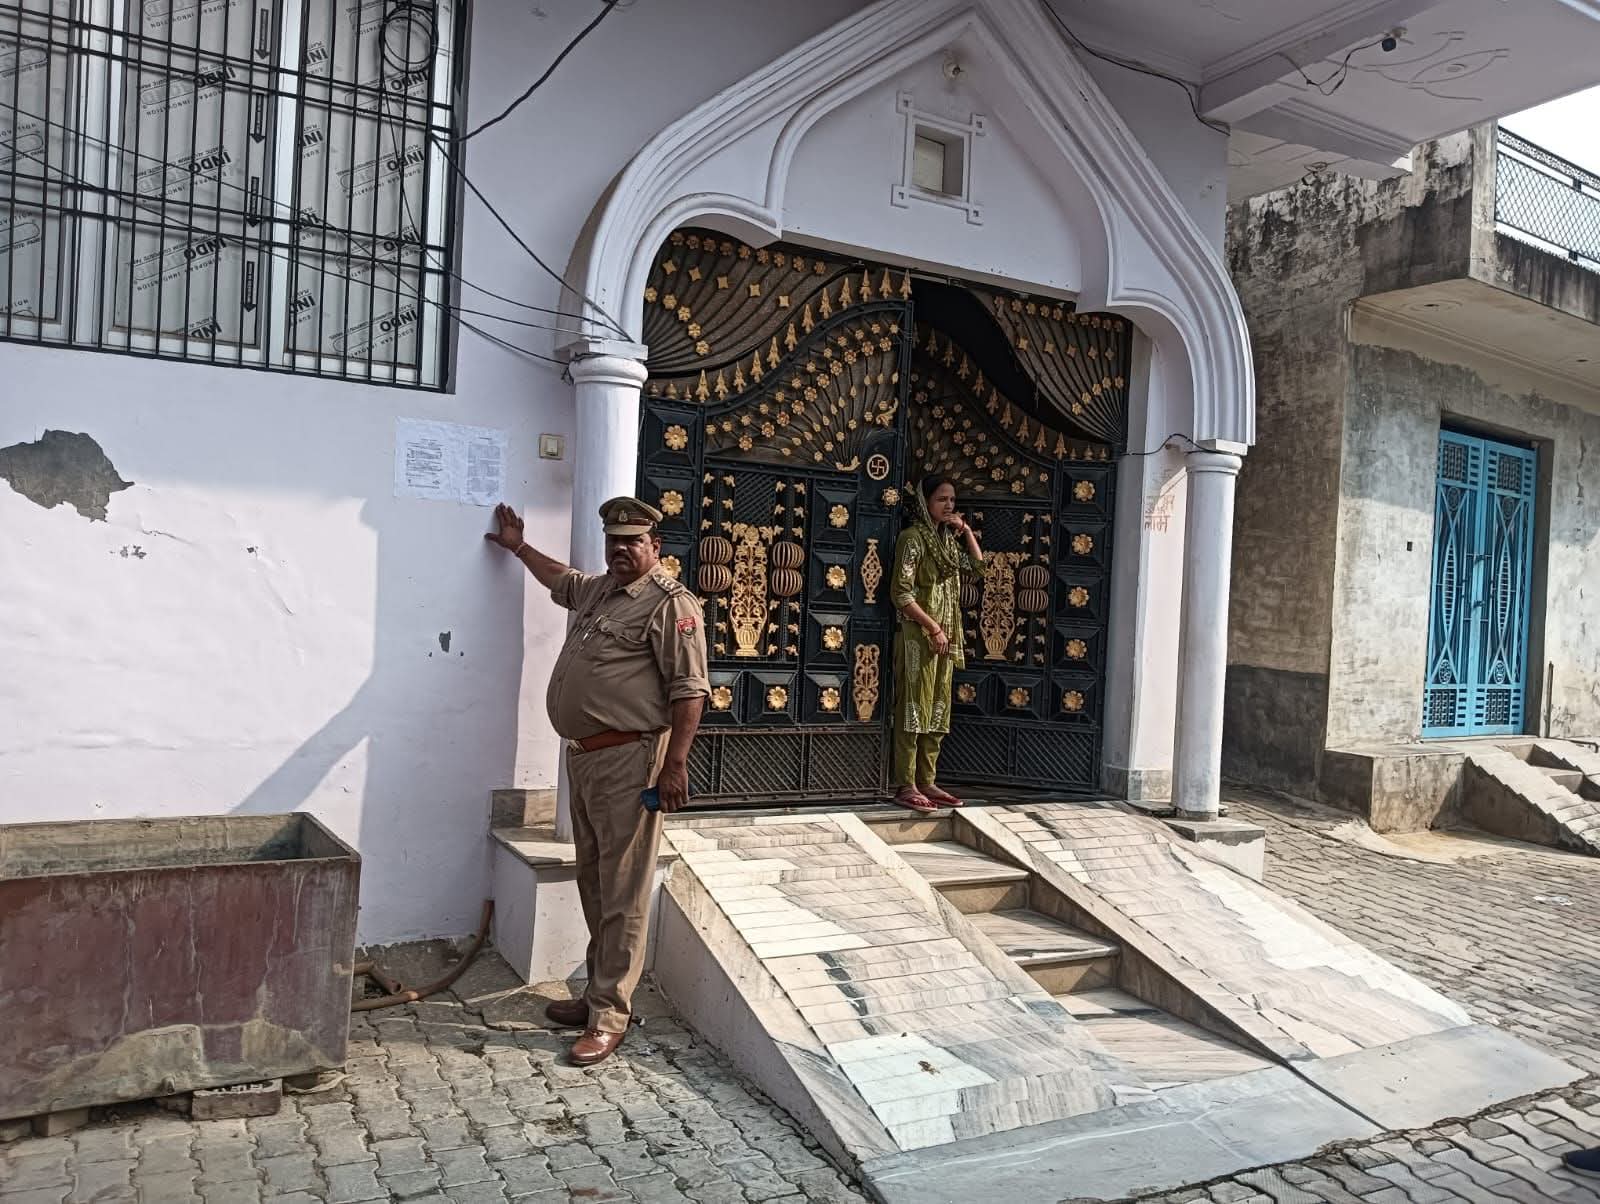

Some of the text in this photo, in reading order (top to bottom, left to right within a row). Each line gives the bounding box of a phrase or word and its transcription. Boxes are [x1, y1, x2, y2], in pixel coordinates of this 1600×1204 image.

[188, 152, 231, 174] INDO
[183, 238, 226, 259] INDO
[380, 309, 417, 332] INDO
